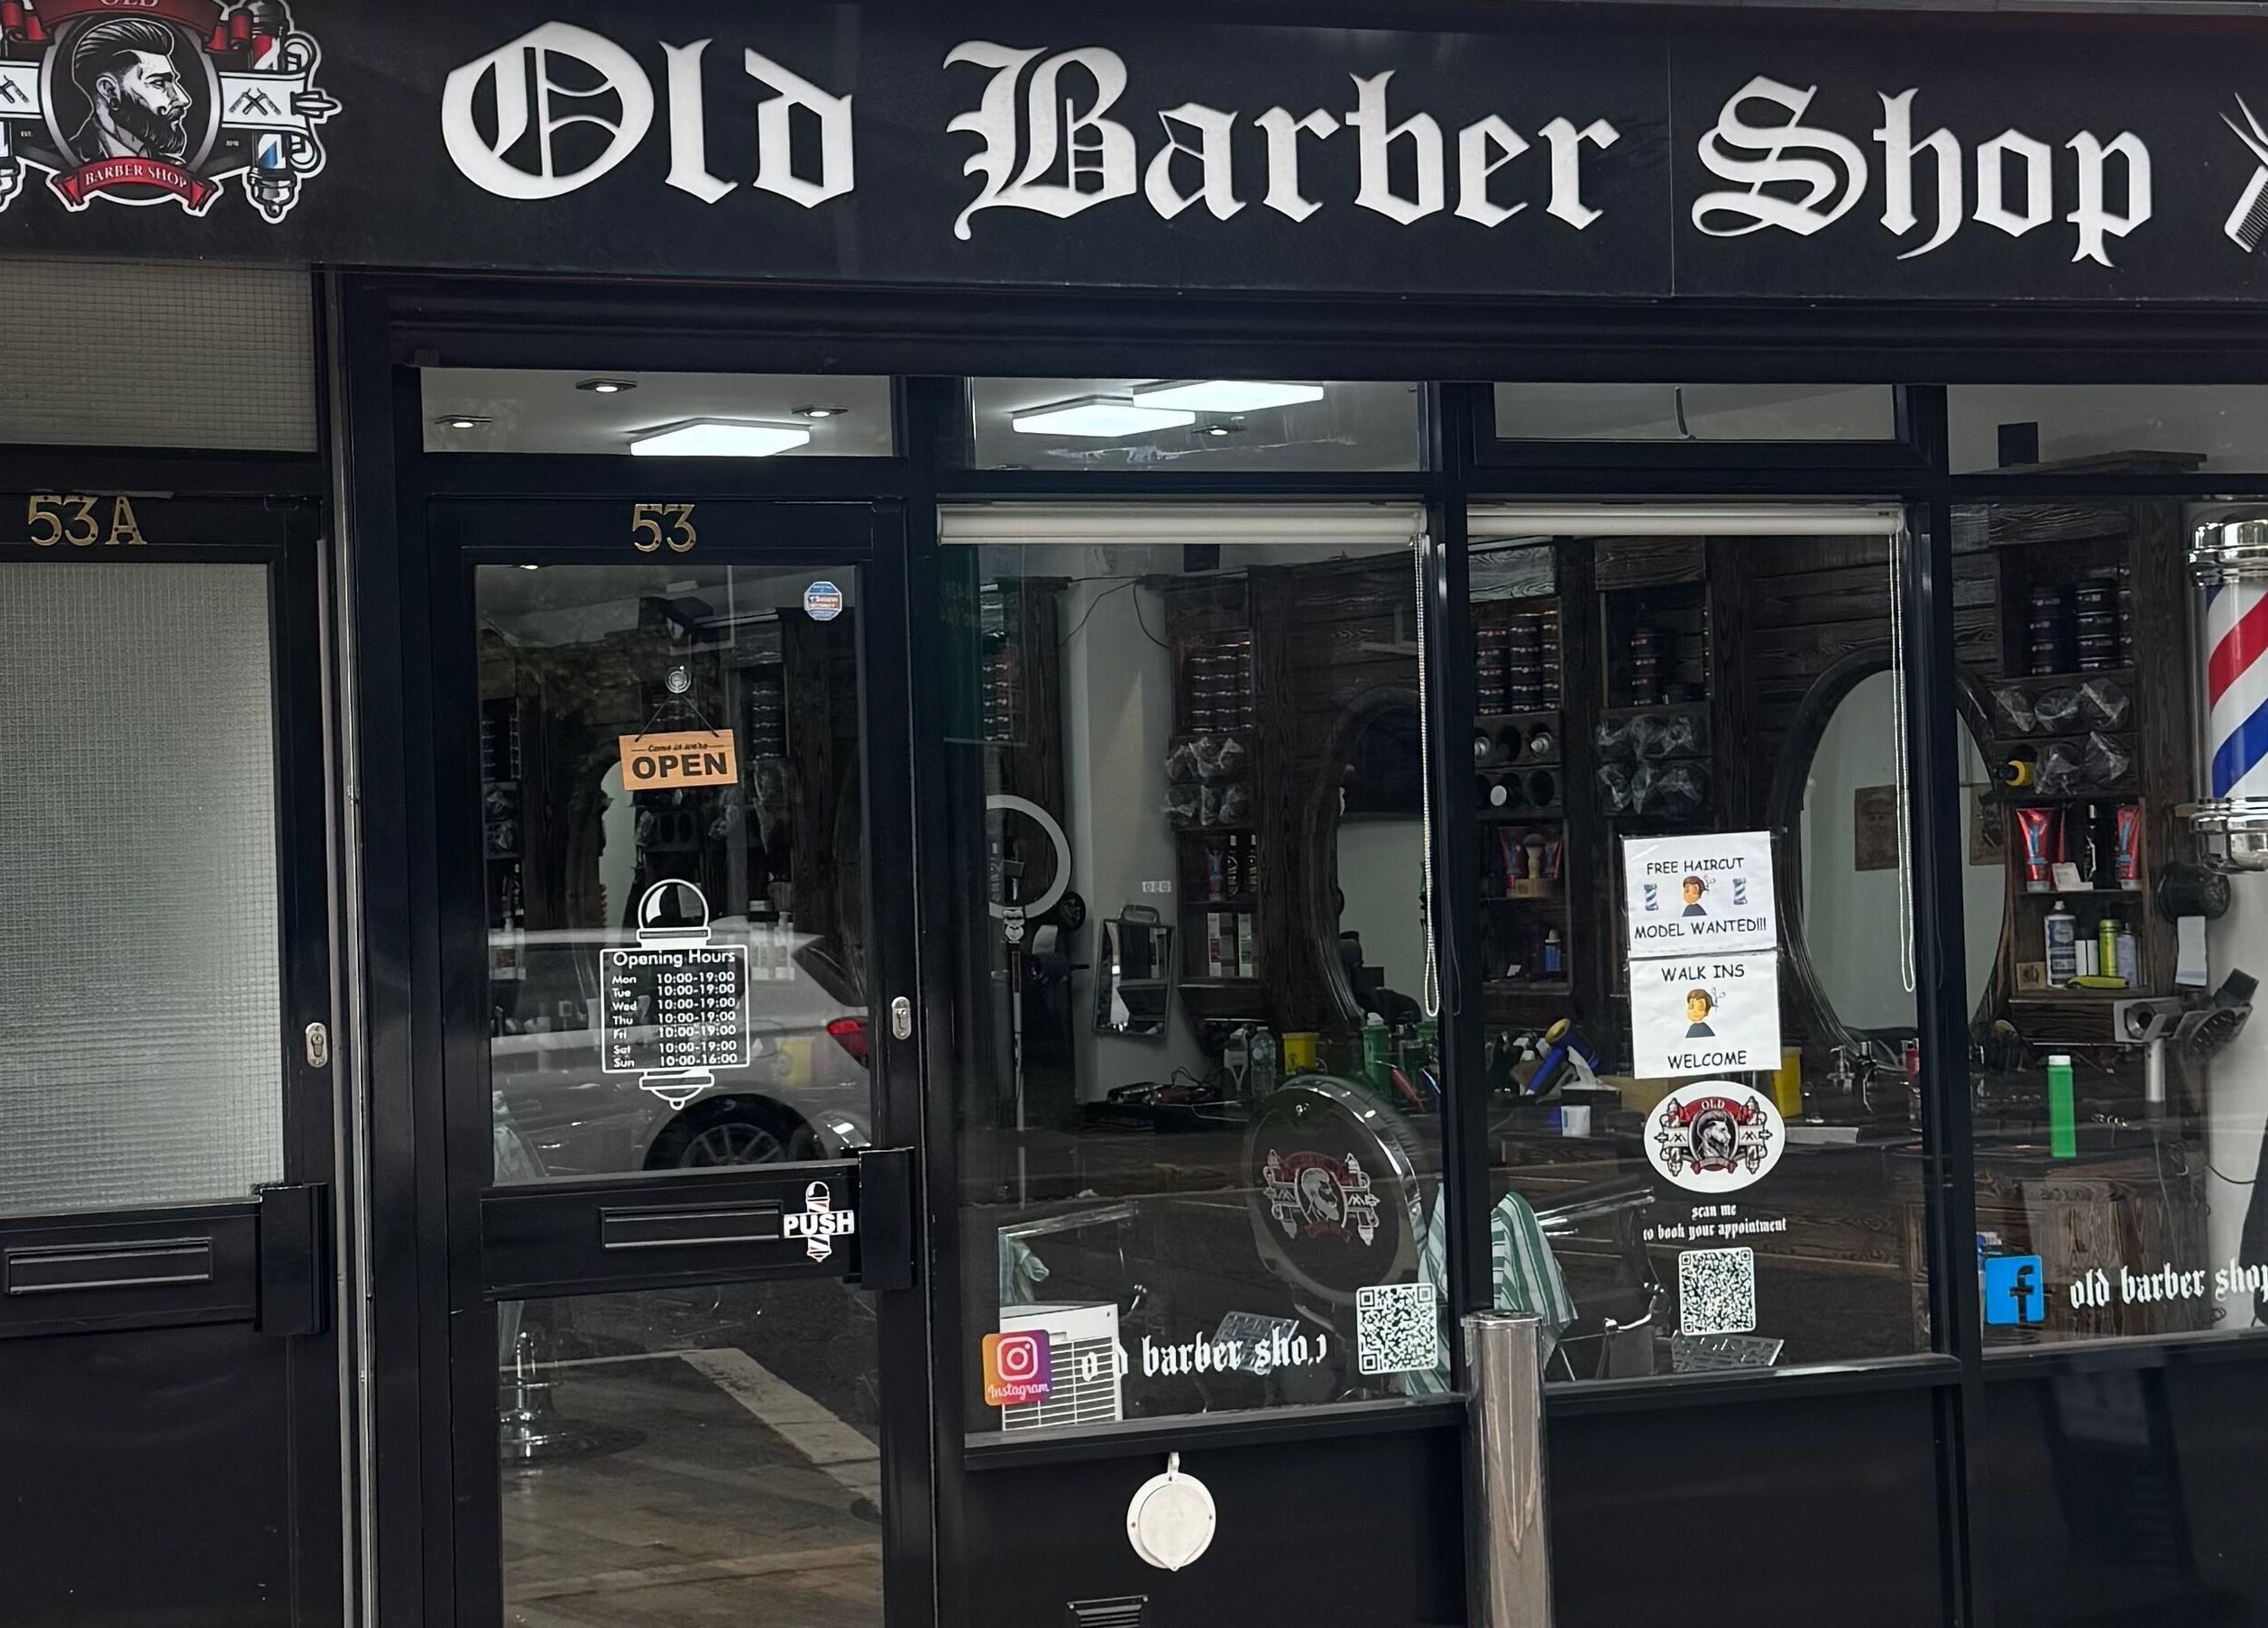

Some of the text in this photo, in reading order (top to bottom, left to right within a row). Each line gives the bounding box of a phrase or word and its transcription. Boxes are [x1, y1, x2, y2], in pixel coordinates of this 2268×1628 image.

[441, 20, 2153, 268] Old Barber Shop
[86, 164, 187, 188] BARBER SHOP
[632, 503, 697, 552] 53
[632, 752, 728, 780] OPEN
[1647, 857, 1745, 875] FREE HAIRCUT
[1634, 917, 1767, 939] MODEL WANTED!!!
[612, 948, 736, 970] Opening Hours
[611, 971, 736, 985] Mon 10:00-19:00
[1661, 963, 1745, 982] WALK INS
[611, 983, 736, 998] Tue 10:00-19:00
[612, 997, 736, 1011] Wed 10:00-19:00
[612, 1010, 736, 1026] Thu 10:00-19:00
[659, 1025, 737, 1038] 10:00-19:00
[613, 1040, 737, 1054] Sat 10:00-19:00
[613, 1058, 635, 1068] Sun
[1667, 1050, 1748, 1069] WELCOME
[1701, 1099, 1725, 1109] OLD
[1691, 1204, 1737, 1220] scan me
[784, 1210, 854, 1238] PUSH
[1657, 1223, 1685, 1239] book
[1688, 1224, 1715, 1241] your
[1718, 1218, 1787, 1239] appointment
[2070, 1268, 2110, 1309] old
[2120, 1263, 2206, 1305] barber
[1141, 1330, 1244, 1377] barber
[987, 1383, 1051, 1401] Instagram
